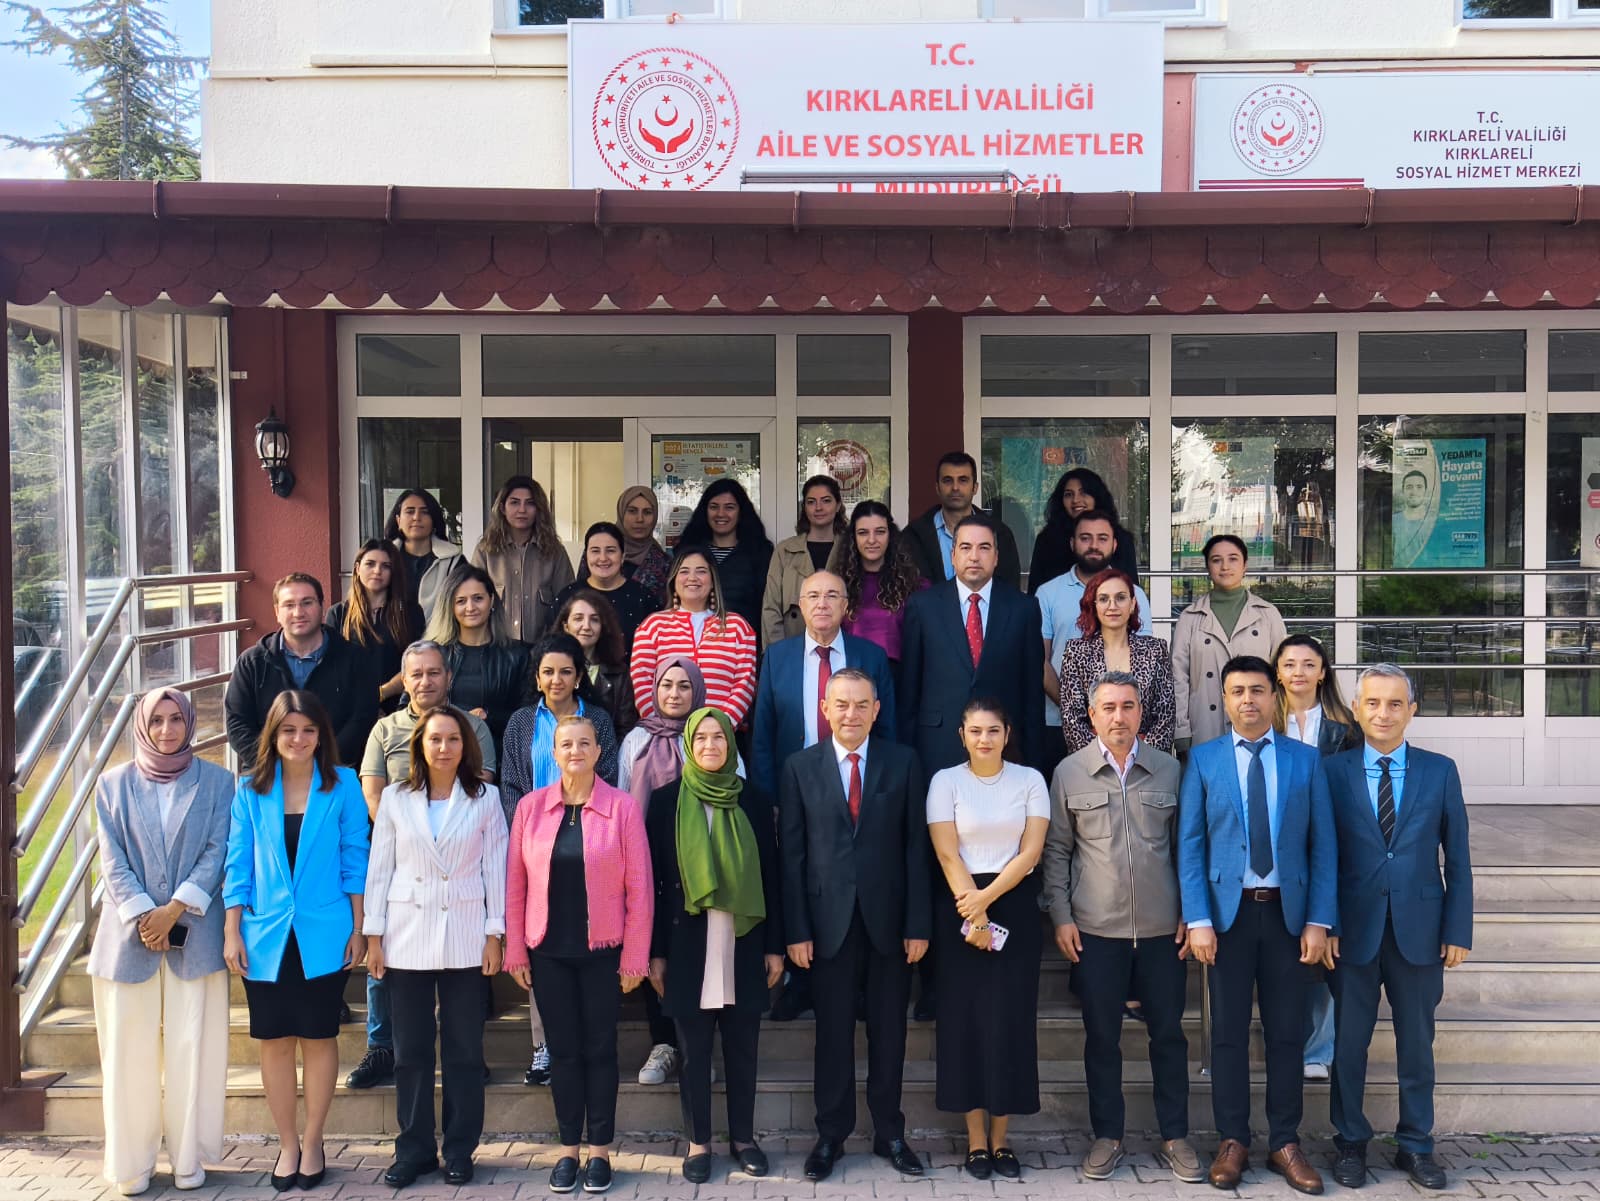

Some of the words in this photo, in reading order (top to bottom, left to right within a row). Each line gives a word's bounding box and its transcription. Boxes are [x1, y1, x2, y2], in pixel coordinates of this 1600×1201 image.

[926, 43, 975, 66] T.C.
[637, 77, 654, 91] AİLE
[654, 74, 665, 82] VE
[667, 74, 696, 92] SOSYAL
[695, 88, 714, 135] HİZMETLER
[806, 84, 968, 112] KIRKLARELİ
[976, 83, 1095, 111] VALİLİĞİ
[1477, 111, 1504, 124] T.C.
[1413, 126, 1501, 142] KIRKLARELİ
[1505, 126, 1567, 142] VALİLİĞİ
[756, 130, 818, 158] AİLE
[824, 135, 860, 158] VE
[867, 134, 977, 158] SOSYAL
[984, 130, 1144, 157] HİZMETLER
[1445, 144, 1533, 160] KIRKLARELİ
[1396, 166, 1453, 179] SOSYAL
[1456, 163, 1512, 178] HİZMET
[1516, 162, 1581, 178] MERKEZİ
[1442, 460, 1483, 473] Hayata
[1441, 470, 1483, 482] Devam!
